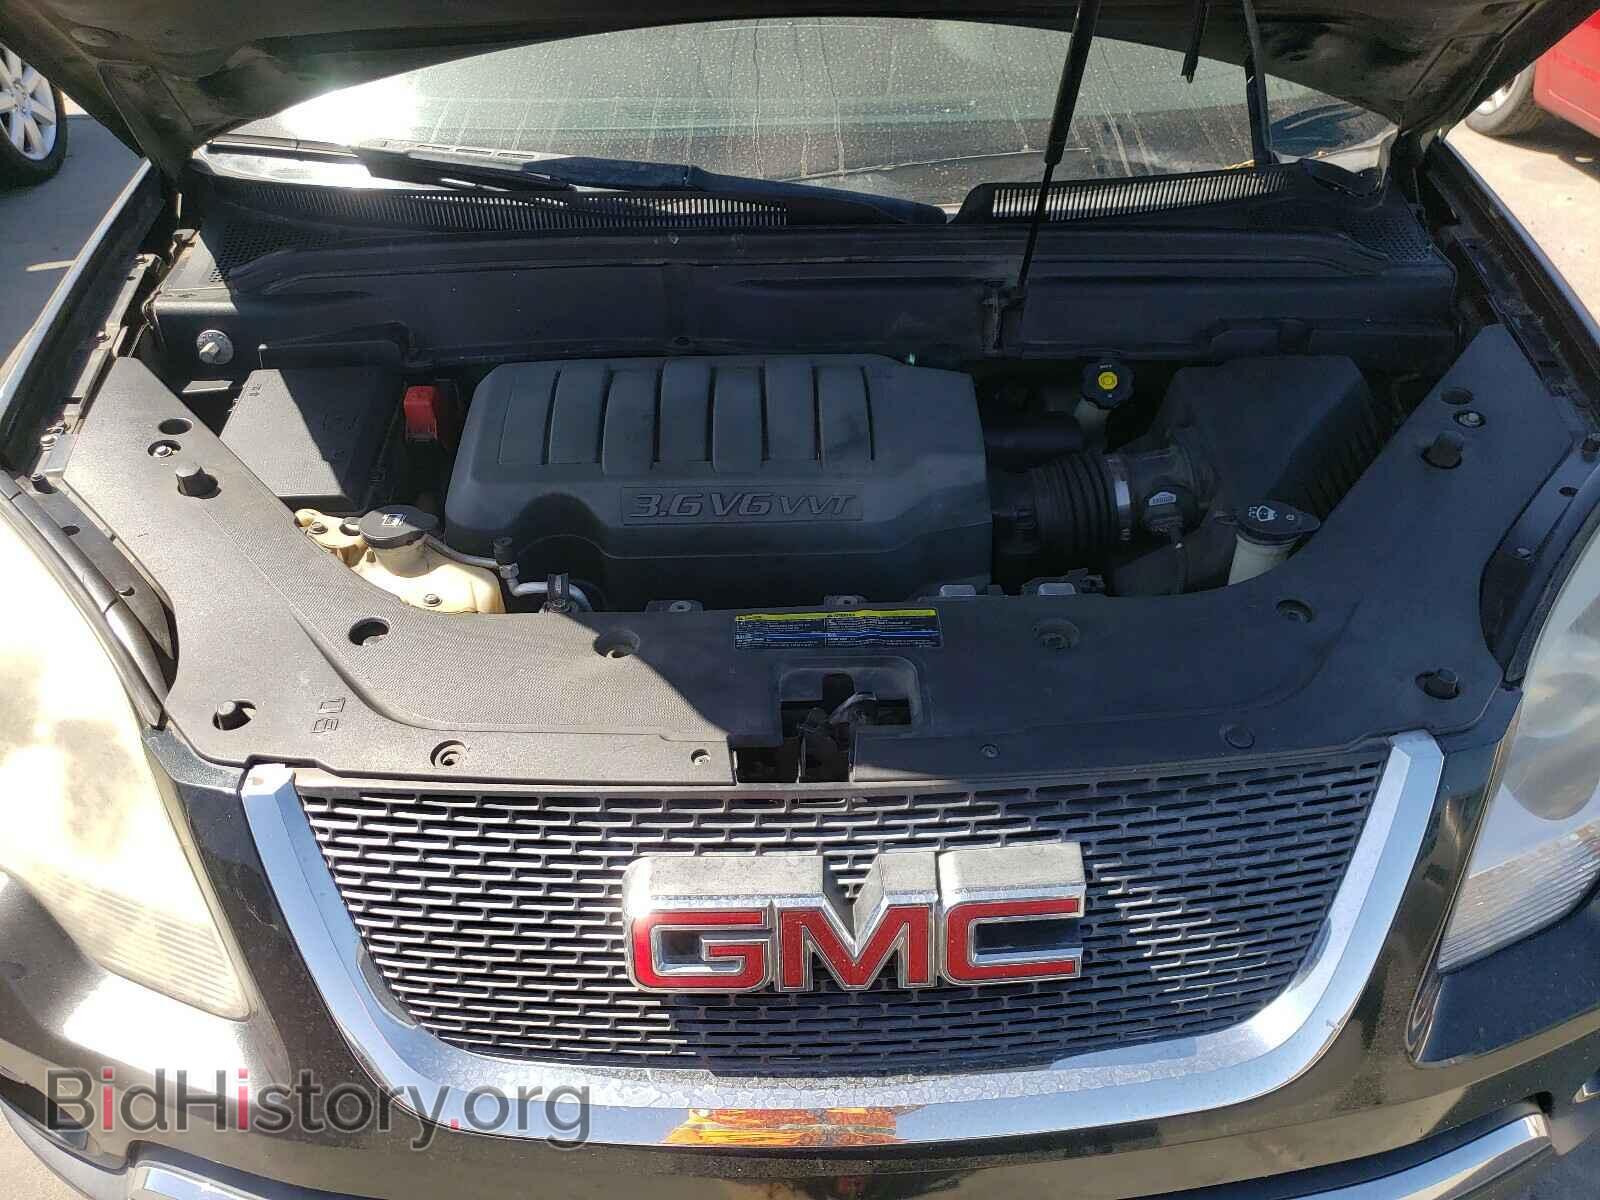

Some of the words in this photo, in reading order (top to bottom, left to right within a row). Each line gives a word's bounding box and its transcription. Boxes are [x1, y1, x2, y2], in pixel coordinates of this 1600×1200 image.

[629, 493, 704, 518] 3.6
[711, 492, 774, 517] V6
[780, 494, 857, 515] VVT
[622, 843, 1086, 993] GMC
